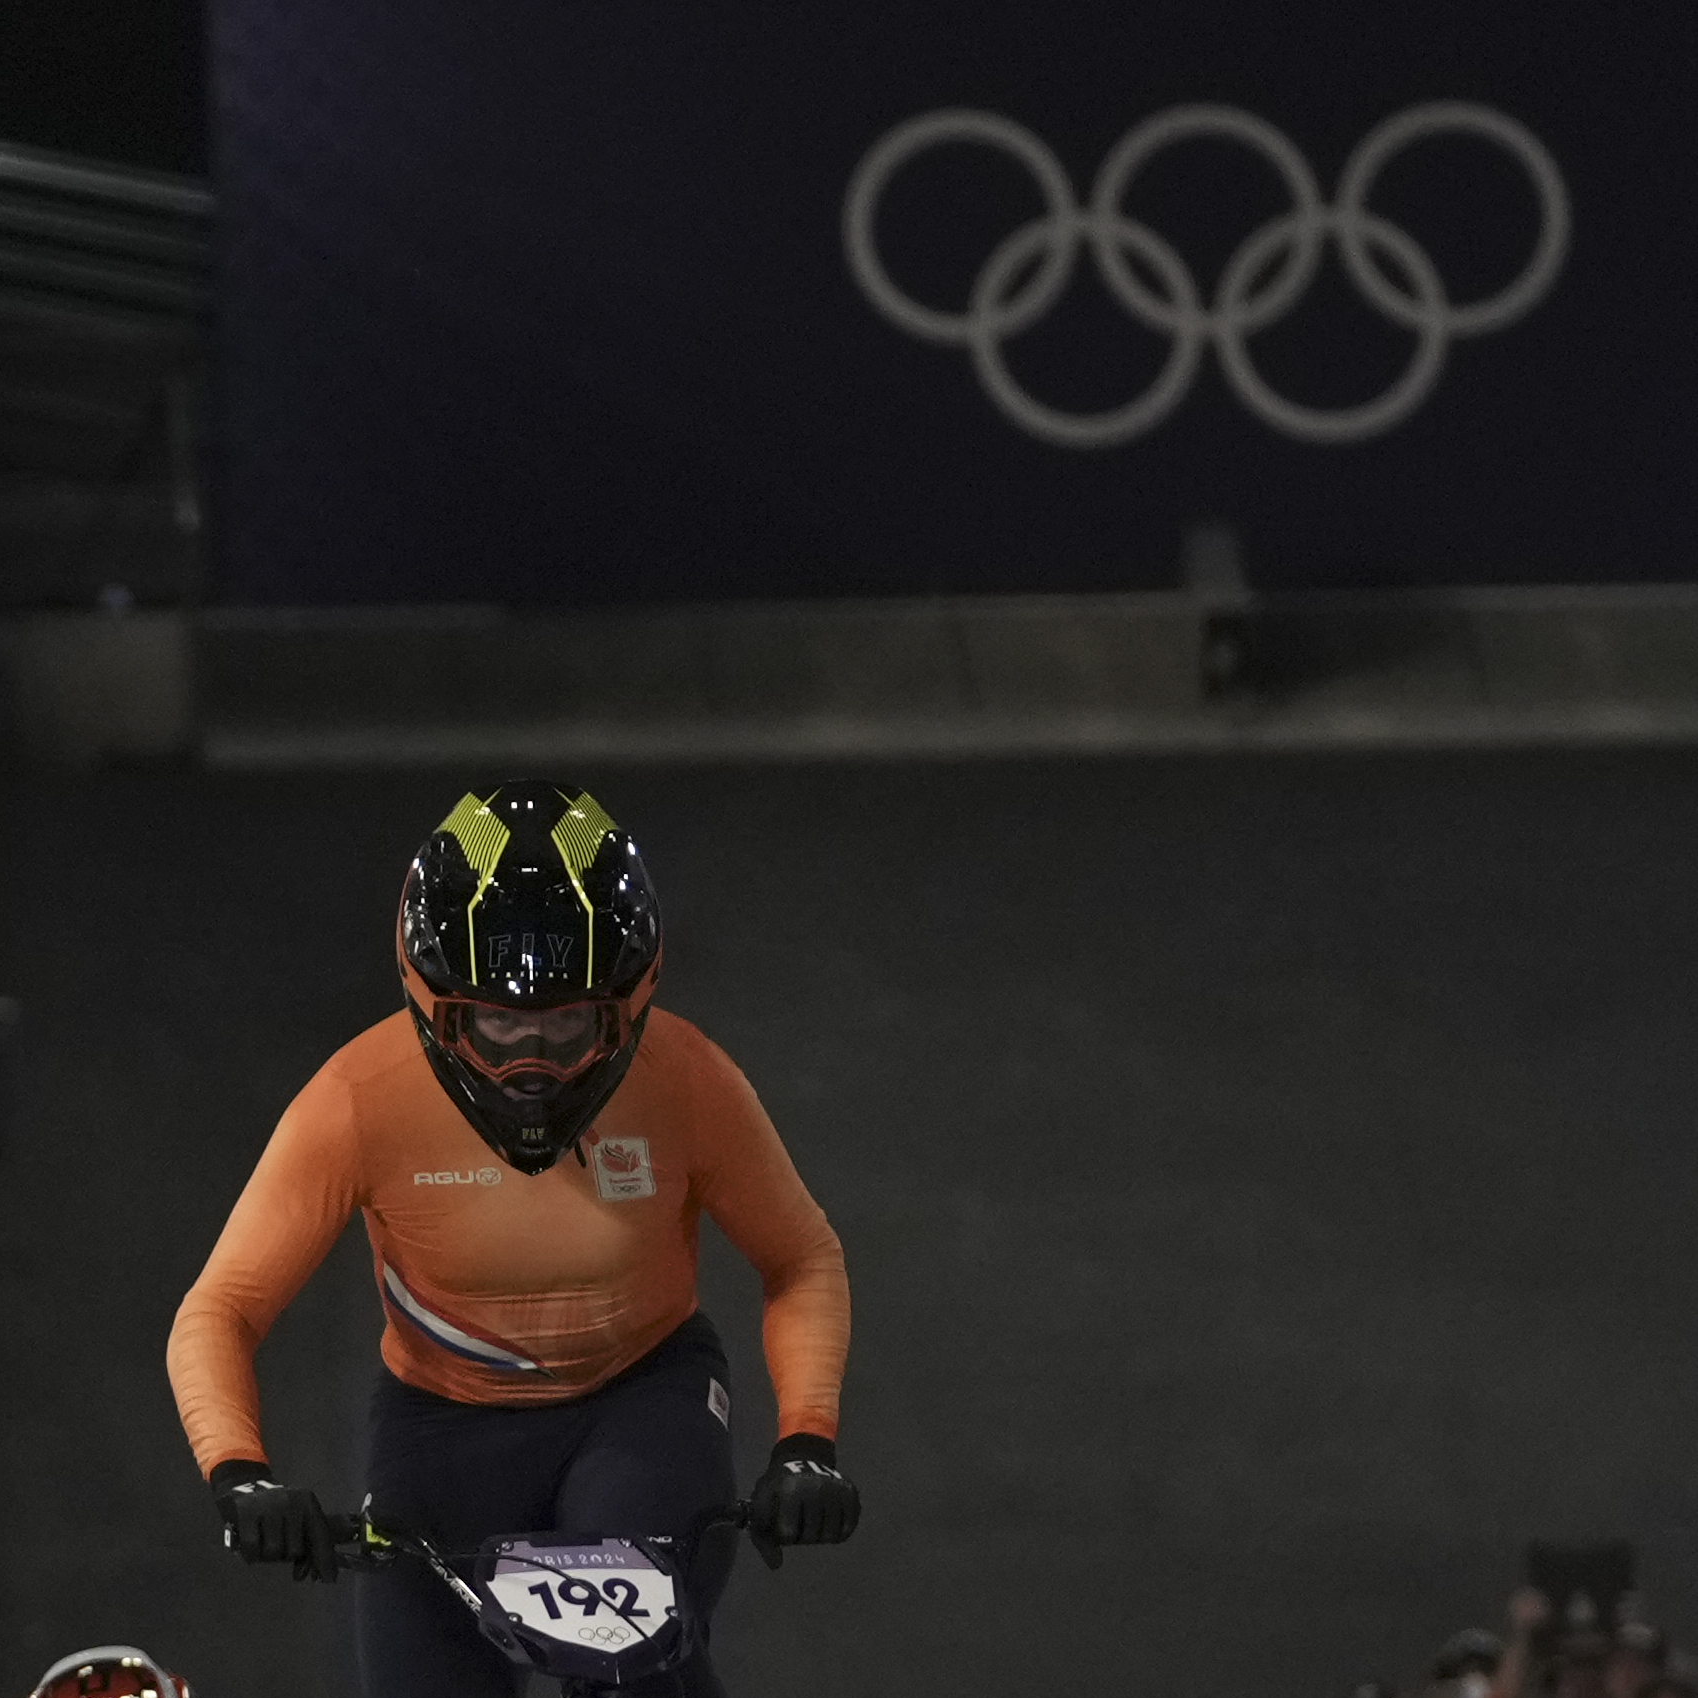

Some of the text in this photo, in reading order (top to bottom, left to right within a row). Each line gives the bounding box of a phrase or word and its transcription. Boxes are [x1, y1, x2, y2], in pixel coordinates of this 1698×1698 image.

[488, 933, 573, 967] FLY
[414, 1170, 475, 1185] AGU
[578, 1552, 626, 1566] 2024
[528, 1577, 651, 1620] 192
